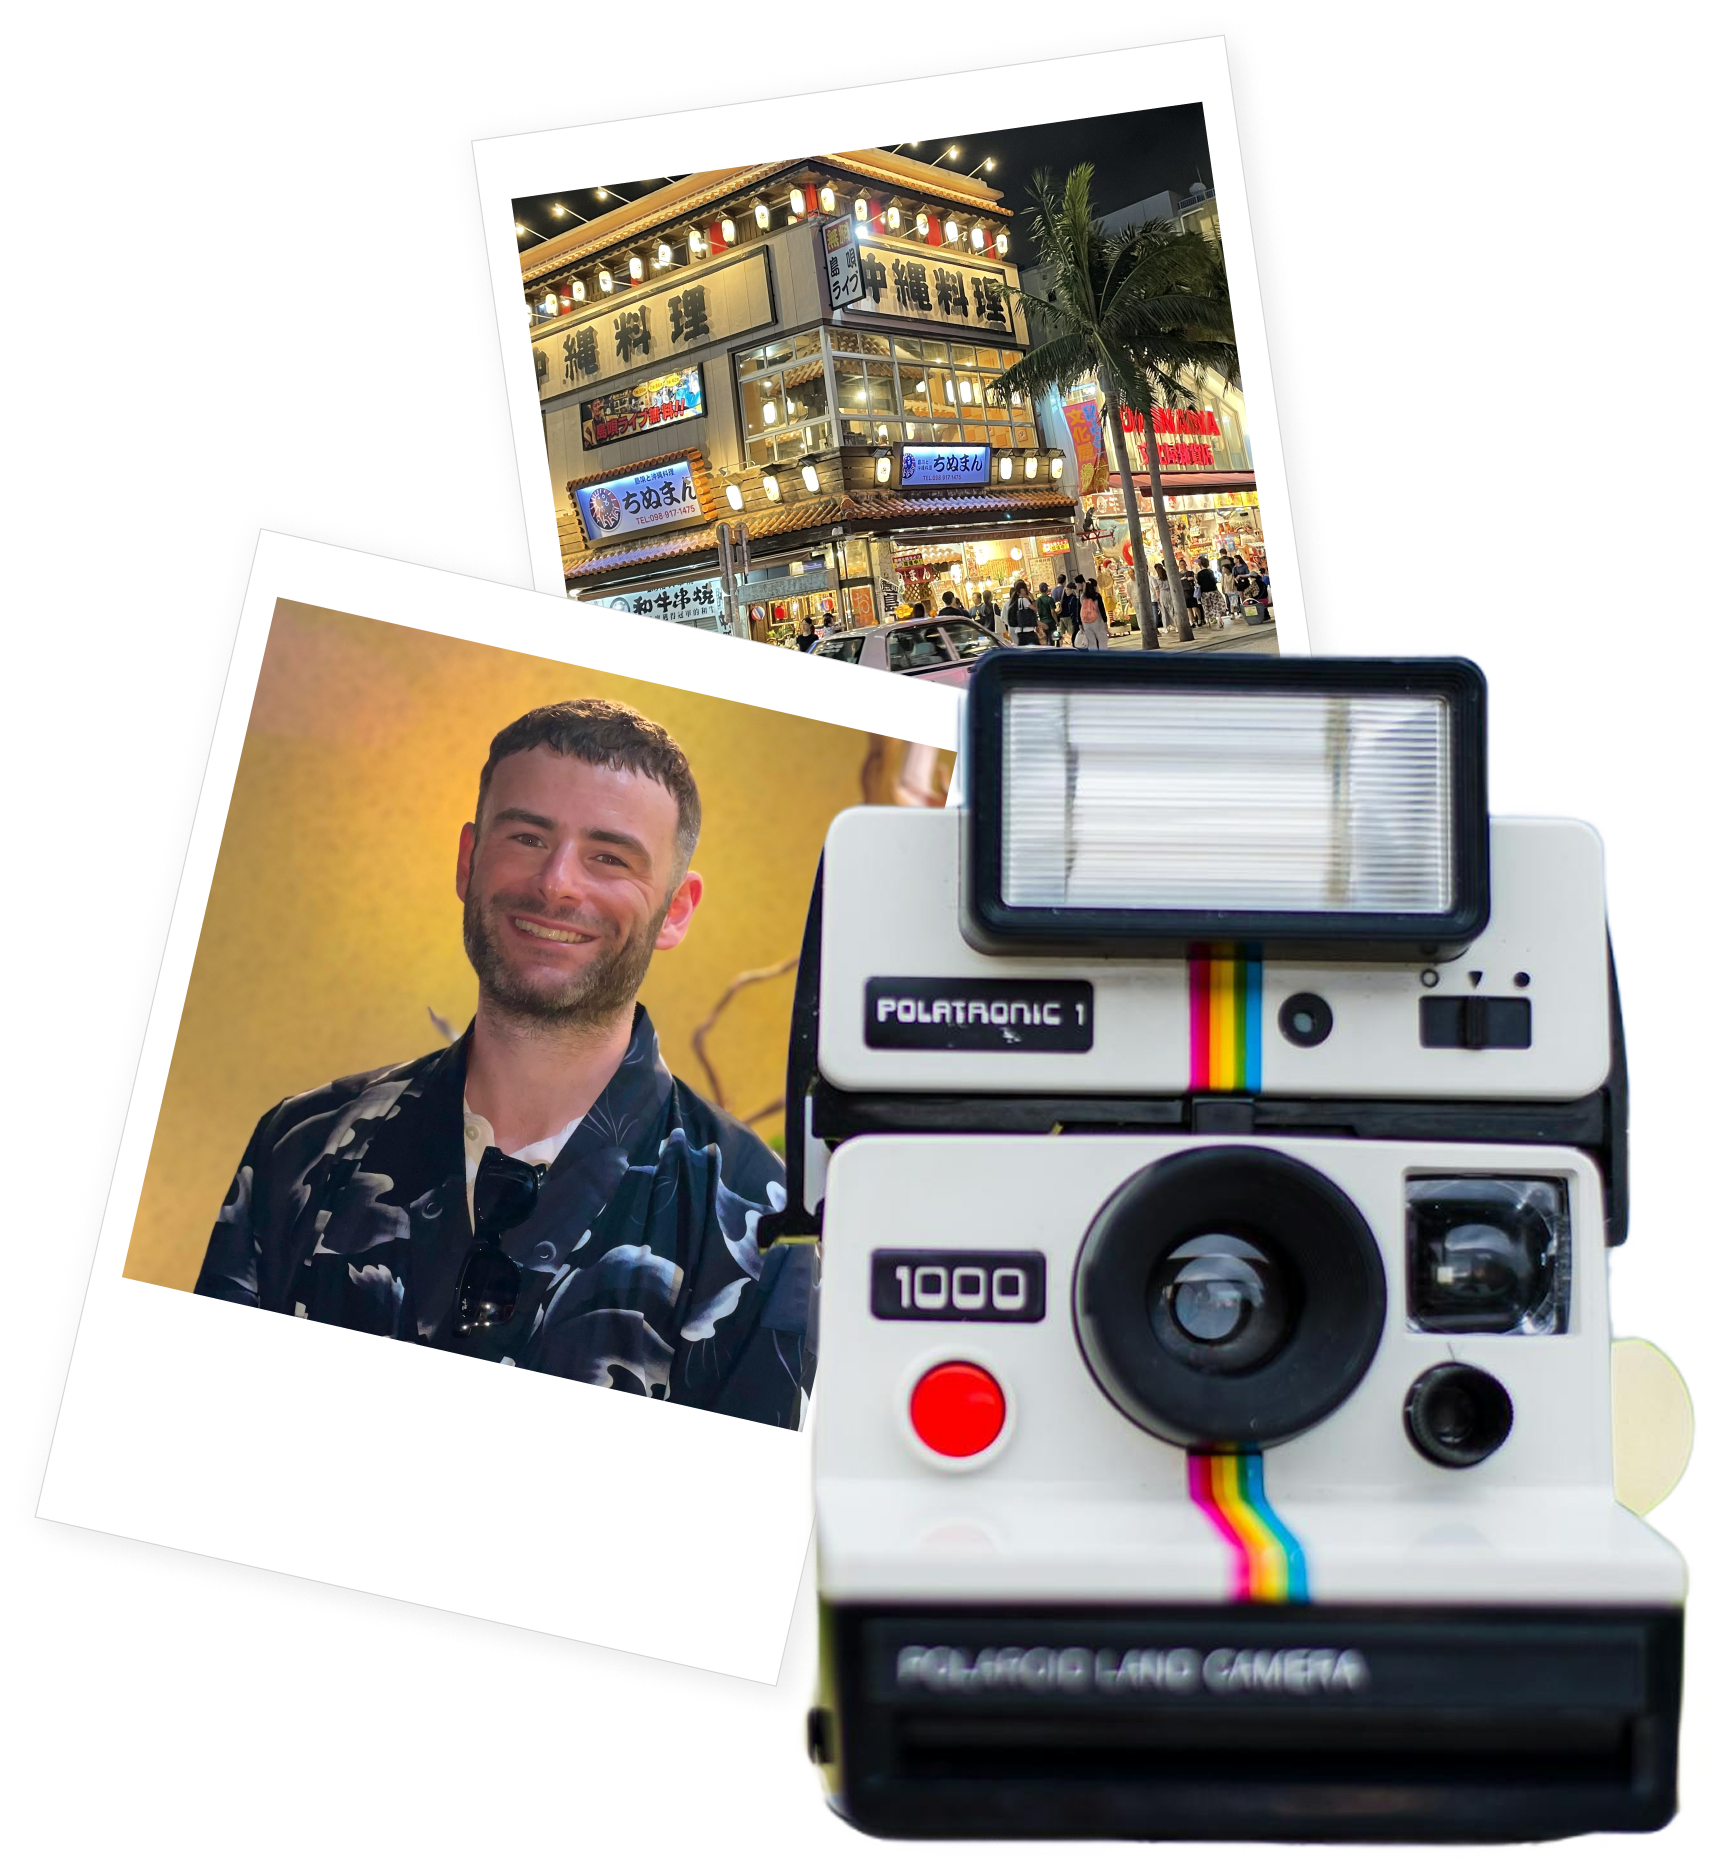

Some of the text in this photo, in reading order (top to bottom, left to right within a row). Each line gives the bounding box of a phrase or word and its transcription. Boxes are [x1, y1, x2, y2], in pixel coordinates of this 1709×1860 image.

[827, 221, 850, 250] 無料
[833, 270, 858, 300] ライブ
[934, 454, 983, 472] ちぬまん
[622, 478, 697, 514] ちぬまん
[877, 999, 1084, 1026] POLATRONIC 1
[895, 1265, 1026, 1311] 1000
[1096, 1646, 1201, 1694] LAND
[1203, 1647, 1369, 1694] CAMERA
